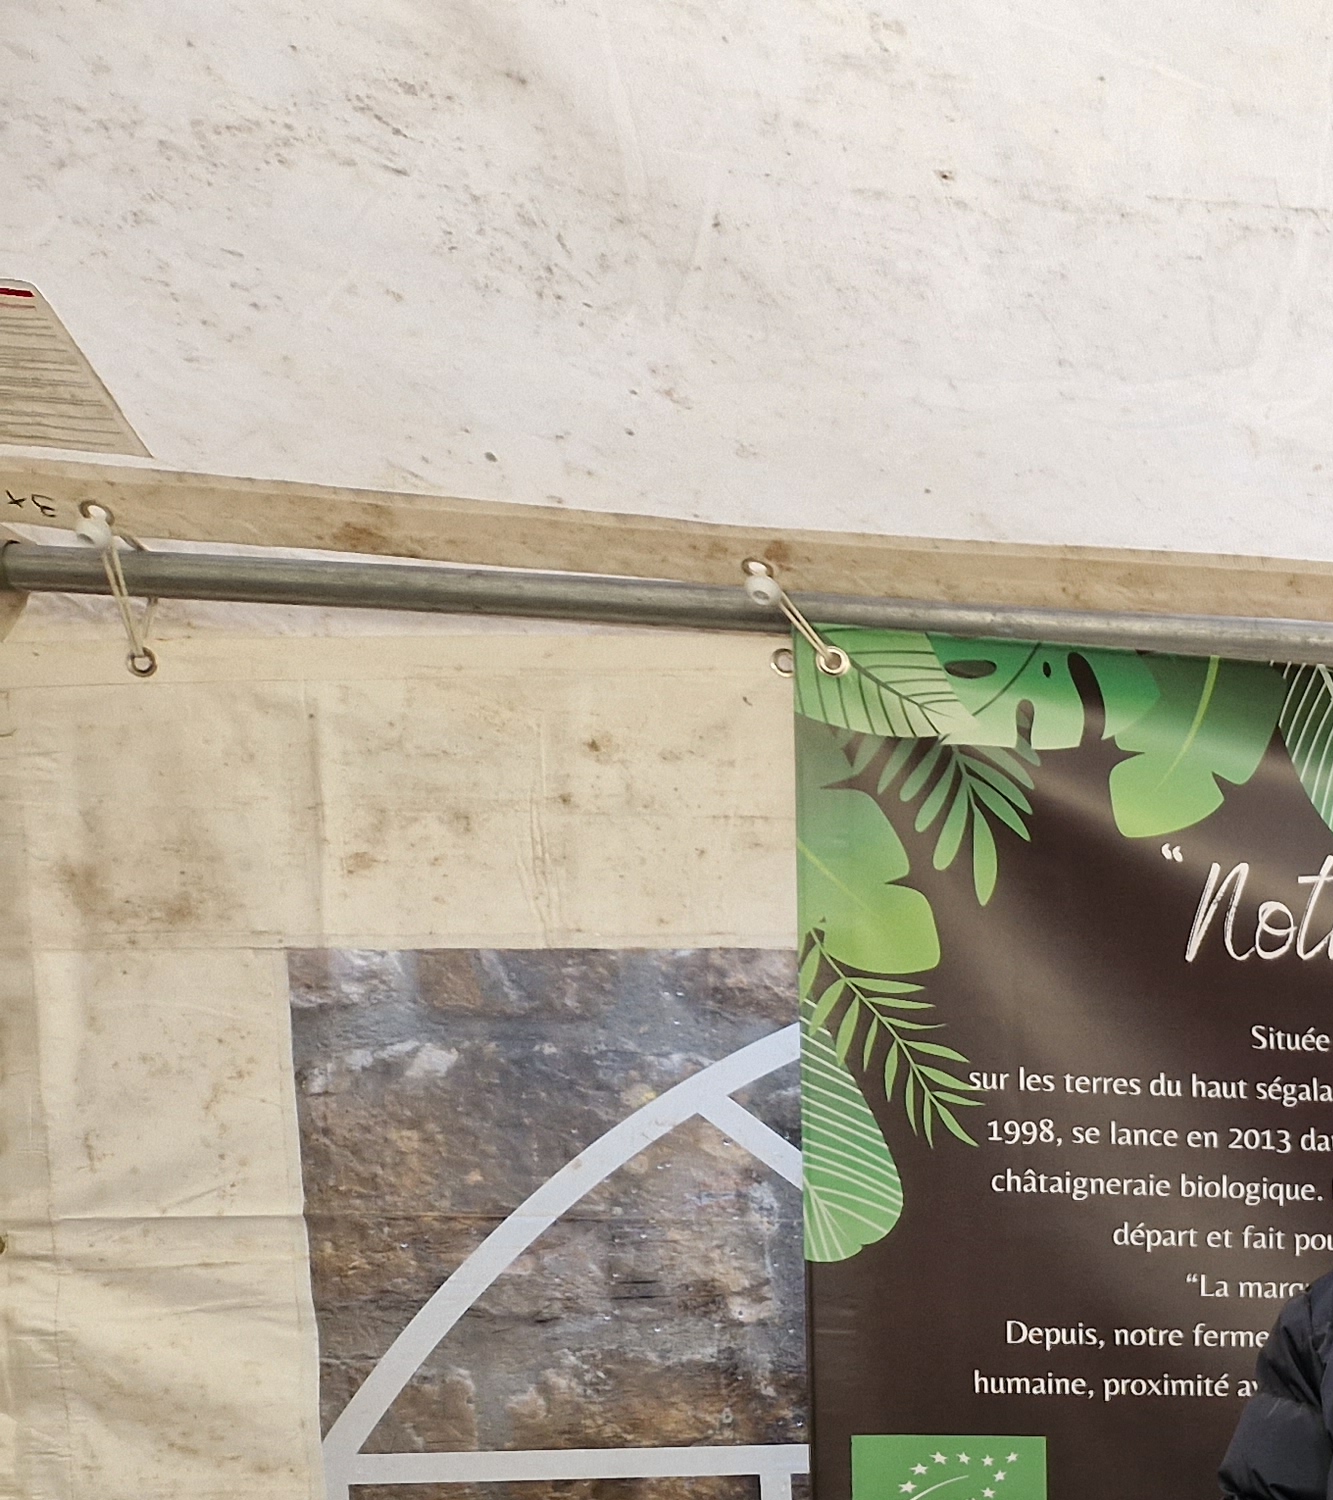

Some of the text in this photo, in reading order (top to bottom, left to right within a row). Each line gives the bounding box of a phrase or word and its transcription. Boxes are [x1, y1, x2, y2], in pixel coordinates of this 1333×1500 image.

[1250, 1024, 1330, 1054] Située
[967, 1069, 1008, 1091] sur
[1018, 1065, 1055, 1093] les
[1063, 1072, 1142, 1097] terres
[1150, 1071, 1183, 1099] du
[1190, 1073, 1248, 1101] haut
[986, 1119, 1064, 1148] 1998,
[1071, 1124, 1101, 1147] se
[1110, 1121, 1178, 1149] lance
[1186, 1127, 1219, 1150] en
[1227, 1127, 1292, 1154] 2013
[990, 1167, 1171, 1200] châtaigneraie
[1179, 1171, 1324, 1207] biologique.
[1111, 1222, 1198, 1254] départ
[1206, 1230, 1234, 1250] et
[1241, 1225, 1286, 1252] fait
[1005, 1319, 1270, 1350] Depuis, notre ferme
[972, 1370, 1095, 1400] humaine,
[1103, 1373, 1230, 1402] proximité
